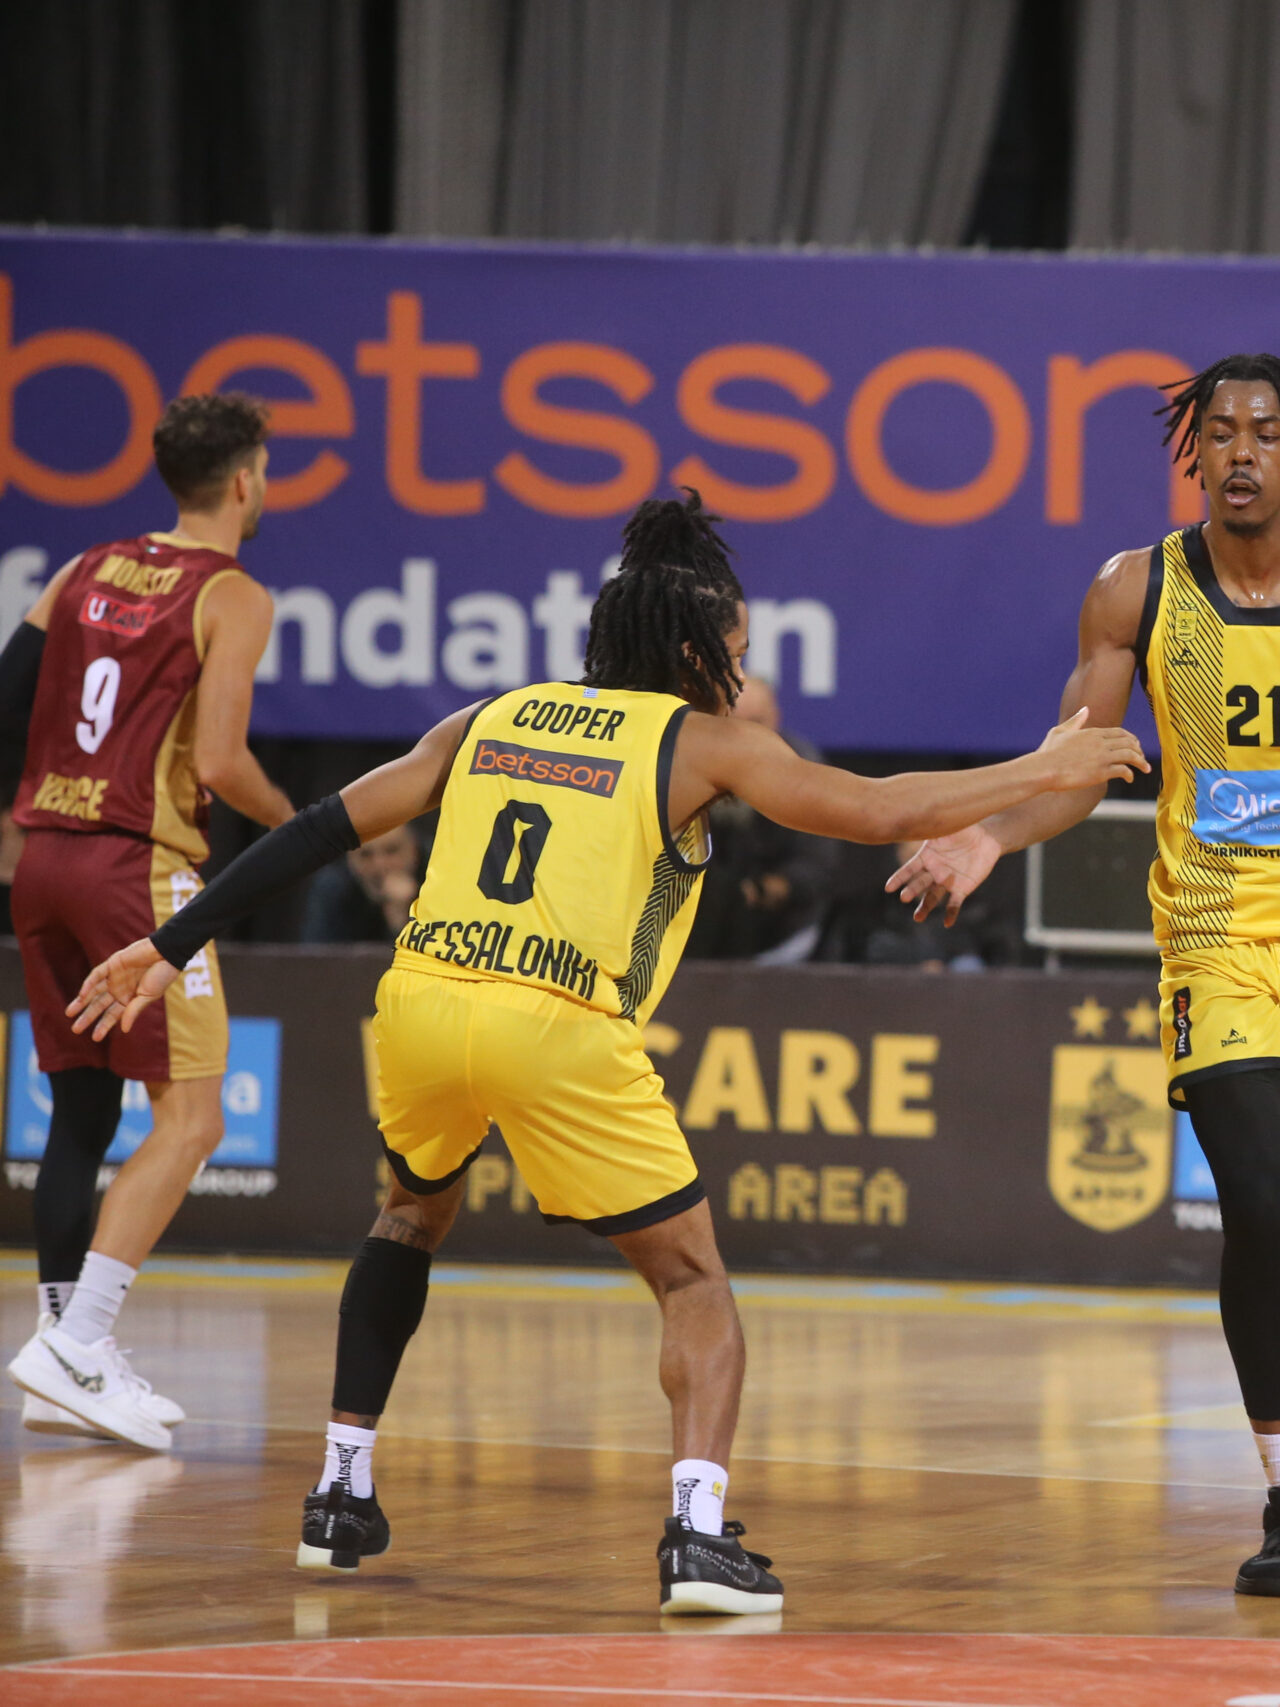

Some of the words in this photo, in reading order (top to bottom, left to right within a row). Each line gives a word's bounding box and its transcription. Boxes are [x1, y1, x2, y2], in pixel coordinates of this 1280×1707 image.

[0, 268, 1205, 527] betsson
[0, 547, 836, 697] fndatn
[76, 656, 121, 755] 9
[512, 699, 626, 742] COOPER
[474, 744, 615, 793] betsson
[476, 798, 553, 905] 0
[727, 1162, 909, 1227] AREA
[335, 1442, 361, 1495] CROSSOV
[675, 1478, 700, 1531] CROSSOV
